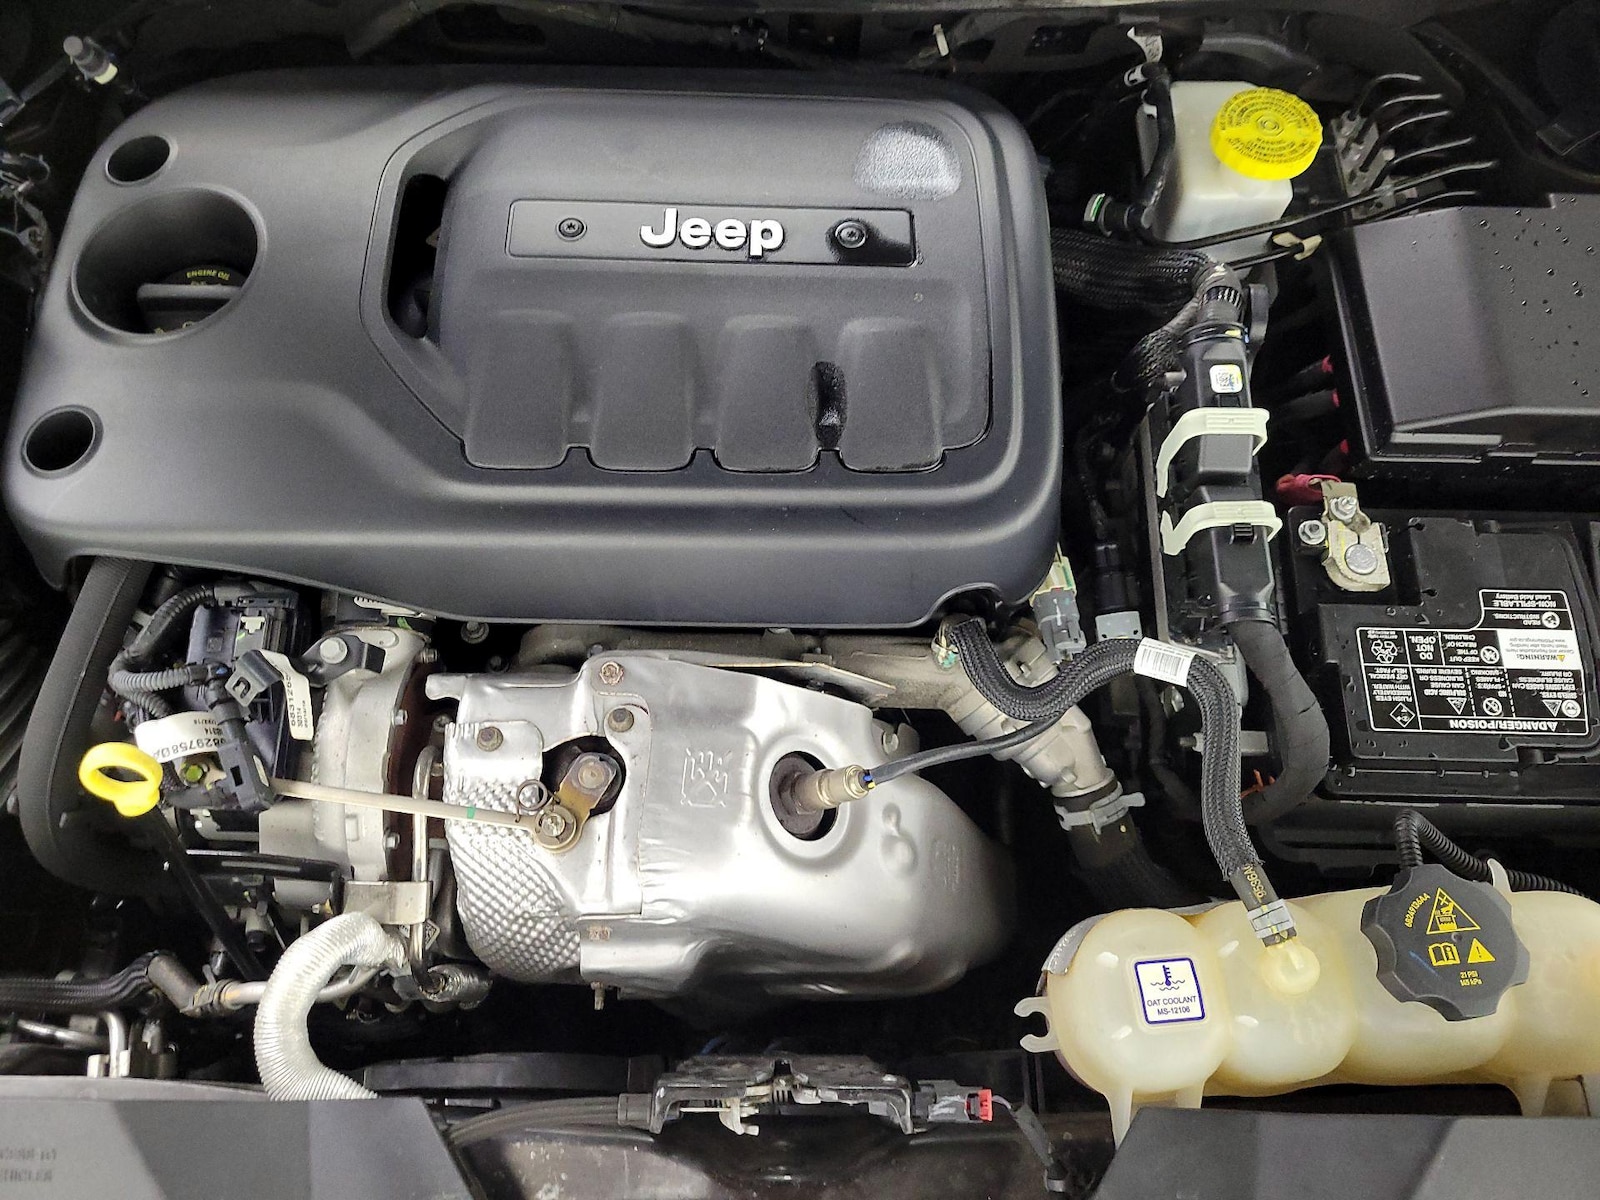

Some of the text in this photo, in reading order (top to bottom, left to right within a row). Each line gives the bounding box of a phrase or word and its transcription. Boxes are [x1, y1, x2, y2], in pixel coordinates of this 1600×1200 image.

[640, 208, 784, 257] Jeep
[187, 269, 230, 280] ENGINE OIL
[1492, 600, 1556, 608] NON-SPILLABLE
[1409, 635, 1436, 644] OPEN.
[1415, 644, 1434, 652] NOT
[1420, 652, 1433, 660] DO
[1449, 720, 1548, 731] DANGER/POISON
[1147, 995, 1197, 1007] OAT COOLANT
